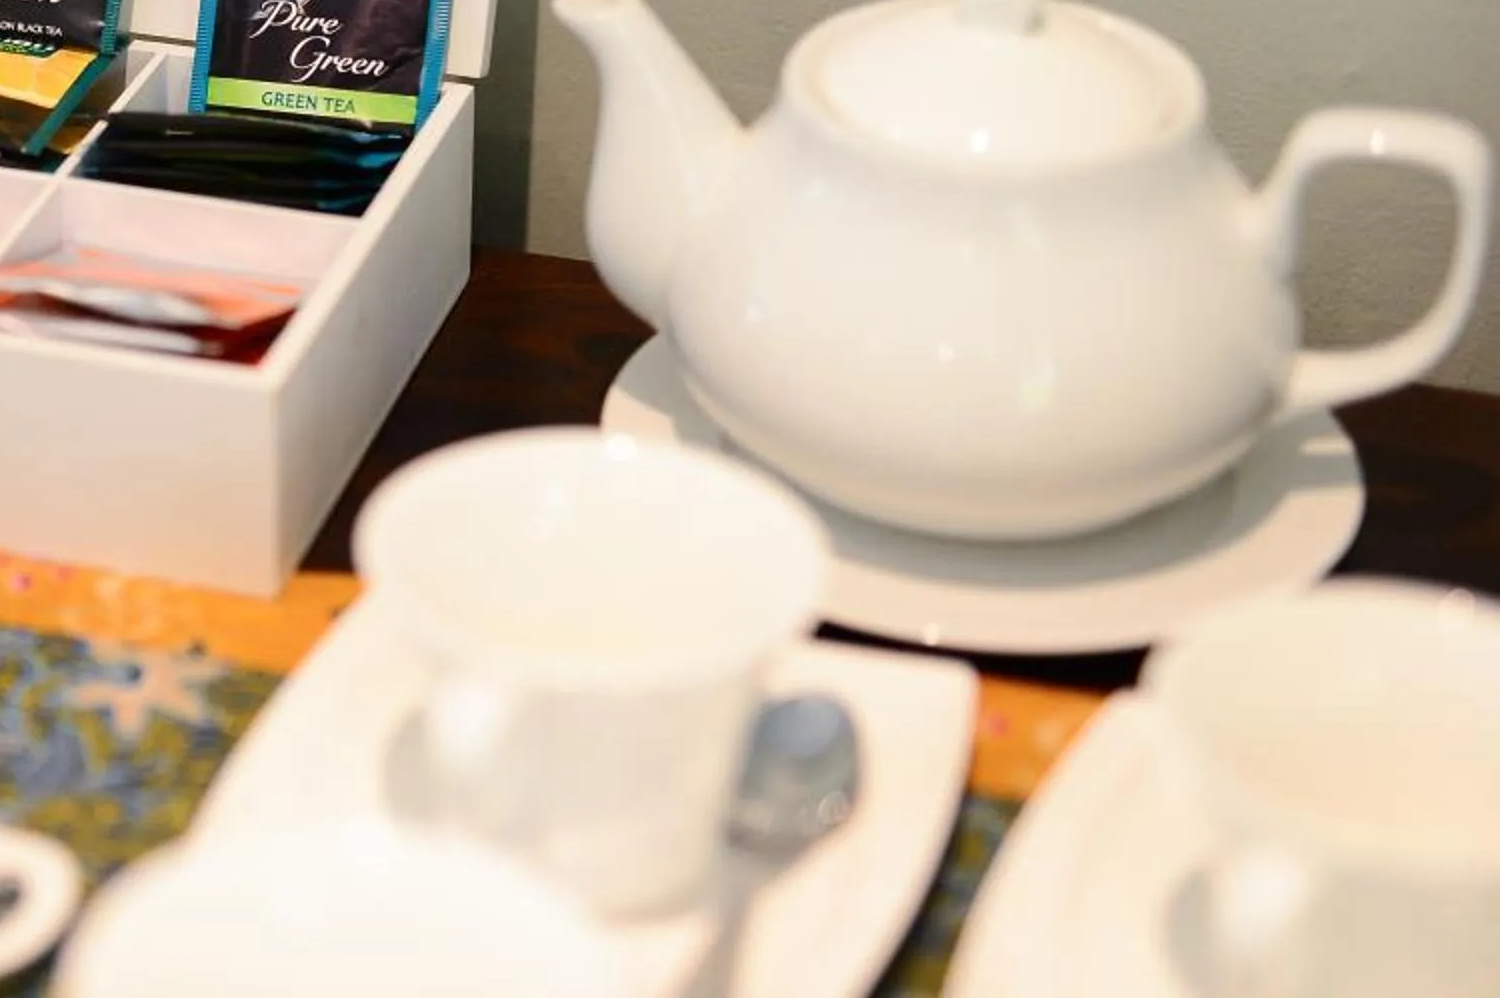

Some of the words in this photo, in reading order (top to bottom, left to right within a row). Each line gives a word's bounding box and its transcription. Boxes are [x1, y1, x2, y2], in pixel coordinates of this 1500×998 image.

[17, 22, 43, 34] BLACK
[45, 25, 63, 37] TEA
[250, 0, 344, 39] Pure
[290, 35, 390, 83] Green
[261, 92, 317, 110] GREEN
[323, 97, 356, 113] TEA
